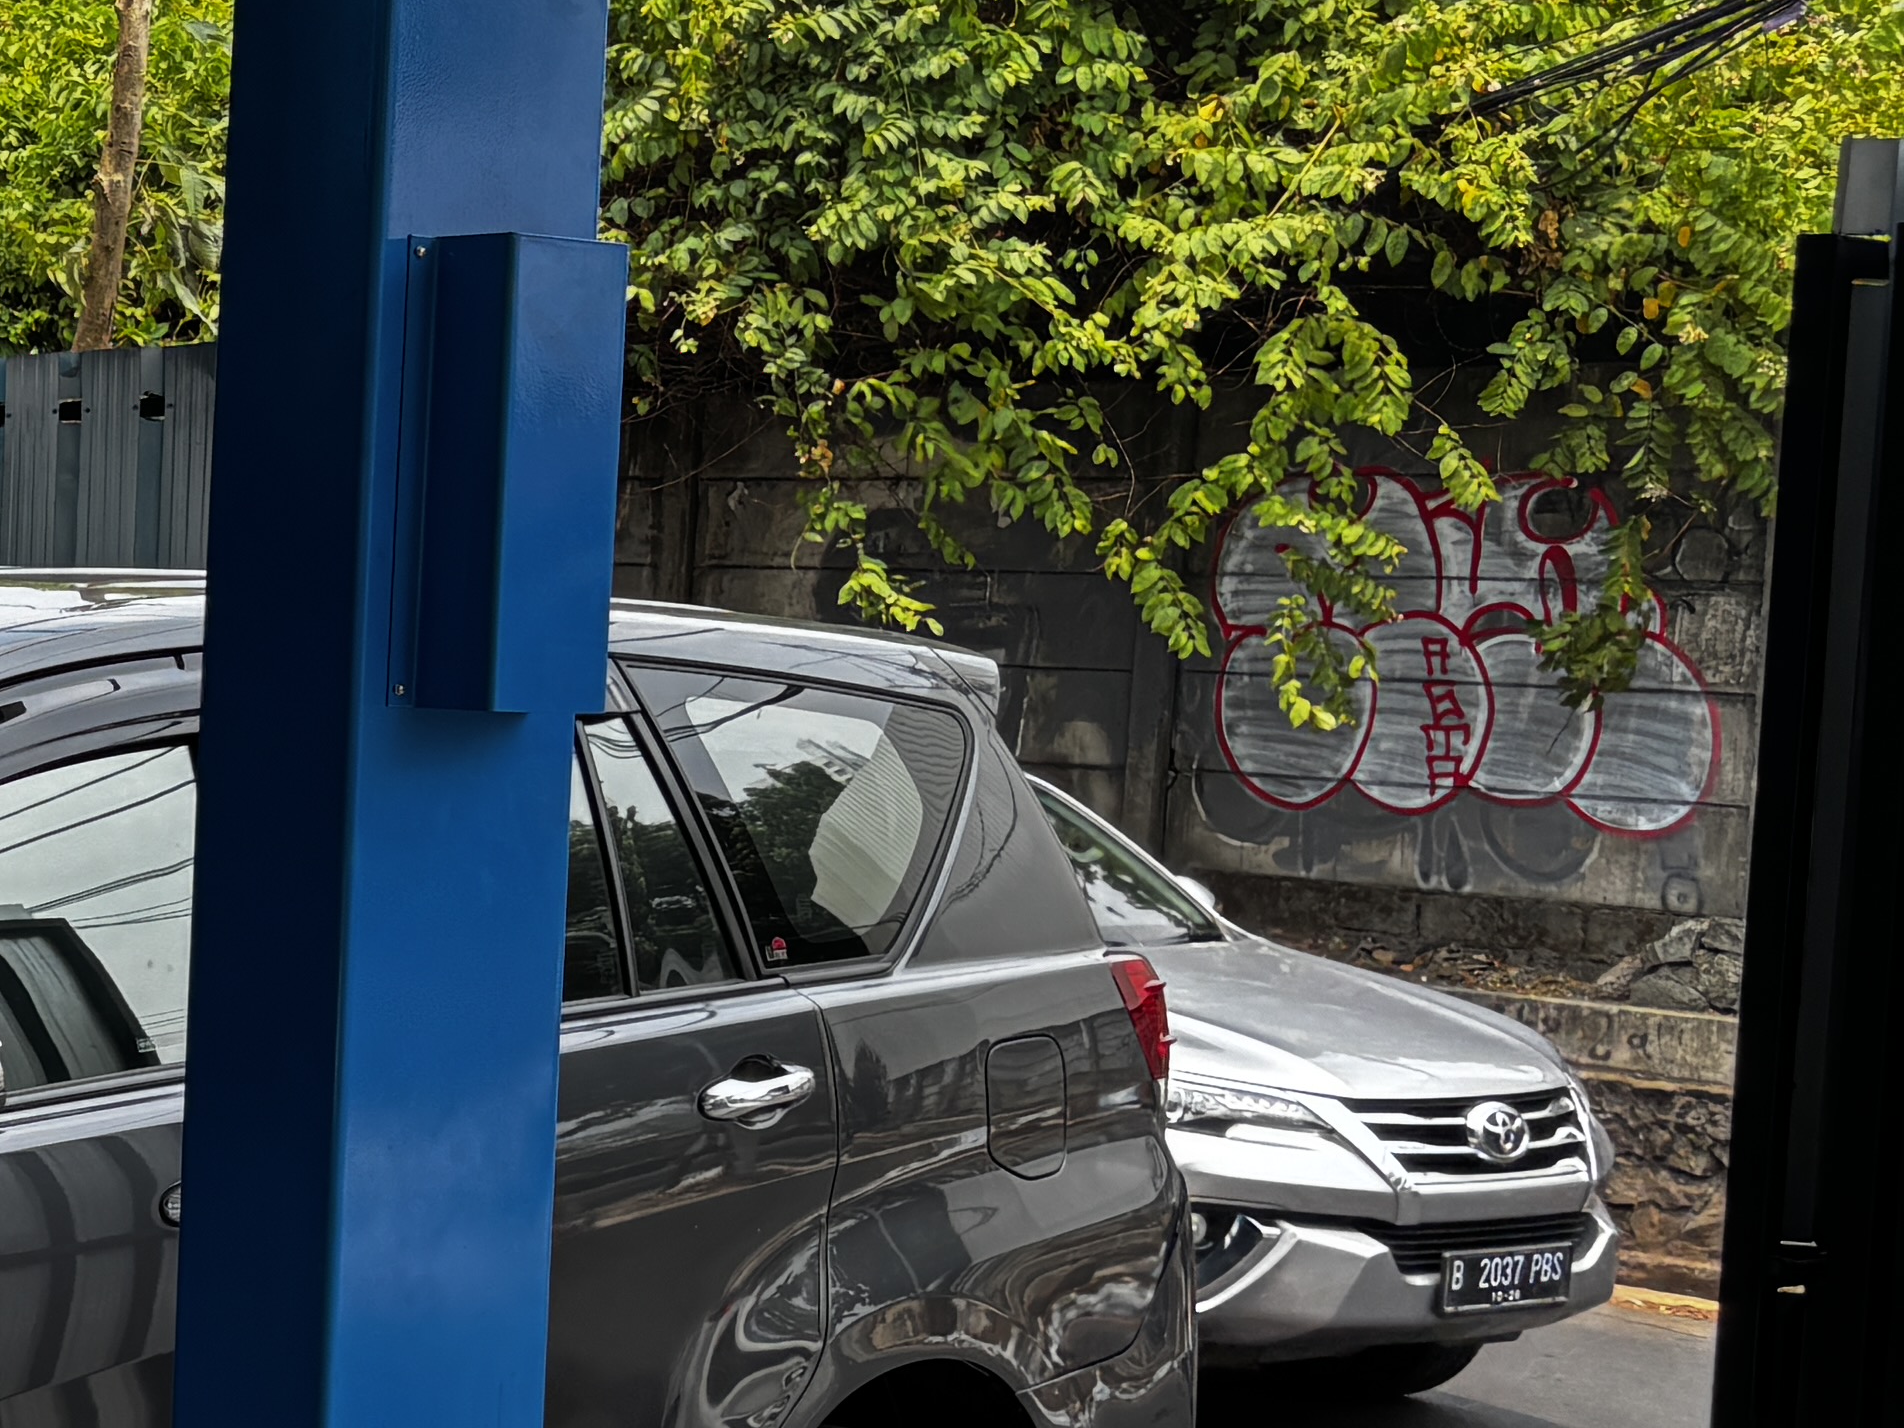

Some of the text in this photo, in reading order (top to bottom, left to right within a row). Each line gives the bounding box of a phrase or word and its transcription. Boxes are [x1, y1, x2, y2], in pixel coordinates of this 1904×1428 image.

[1452, 1252, 1563, 1291] B 2037 PBS
